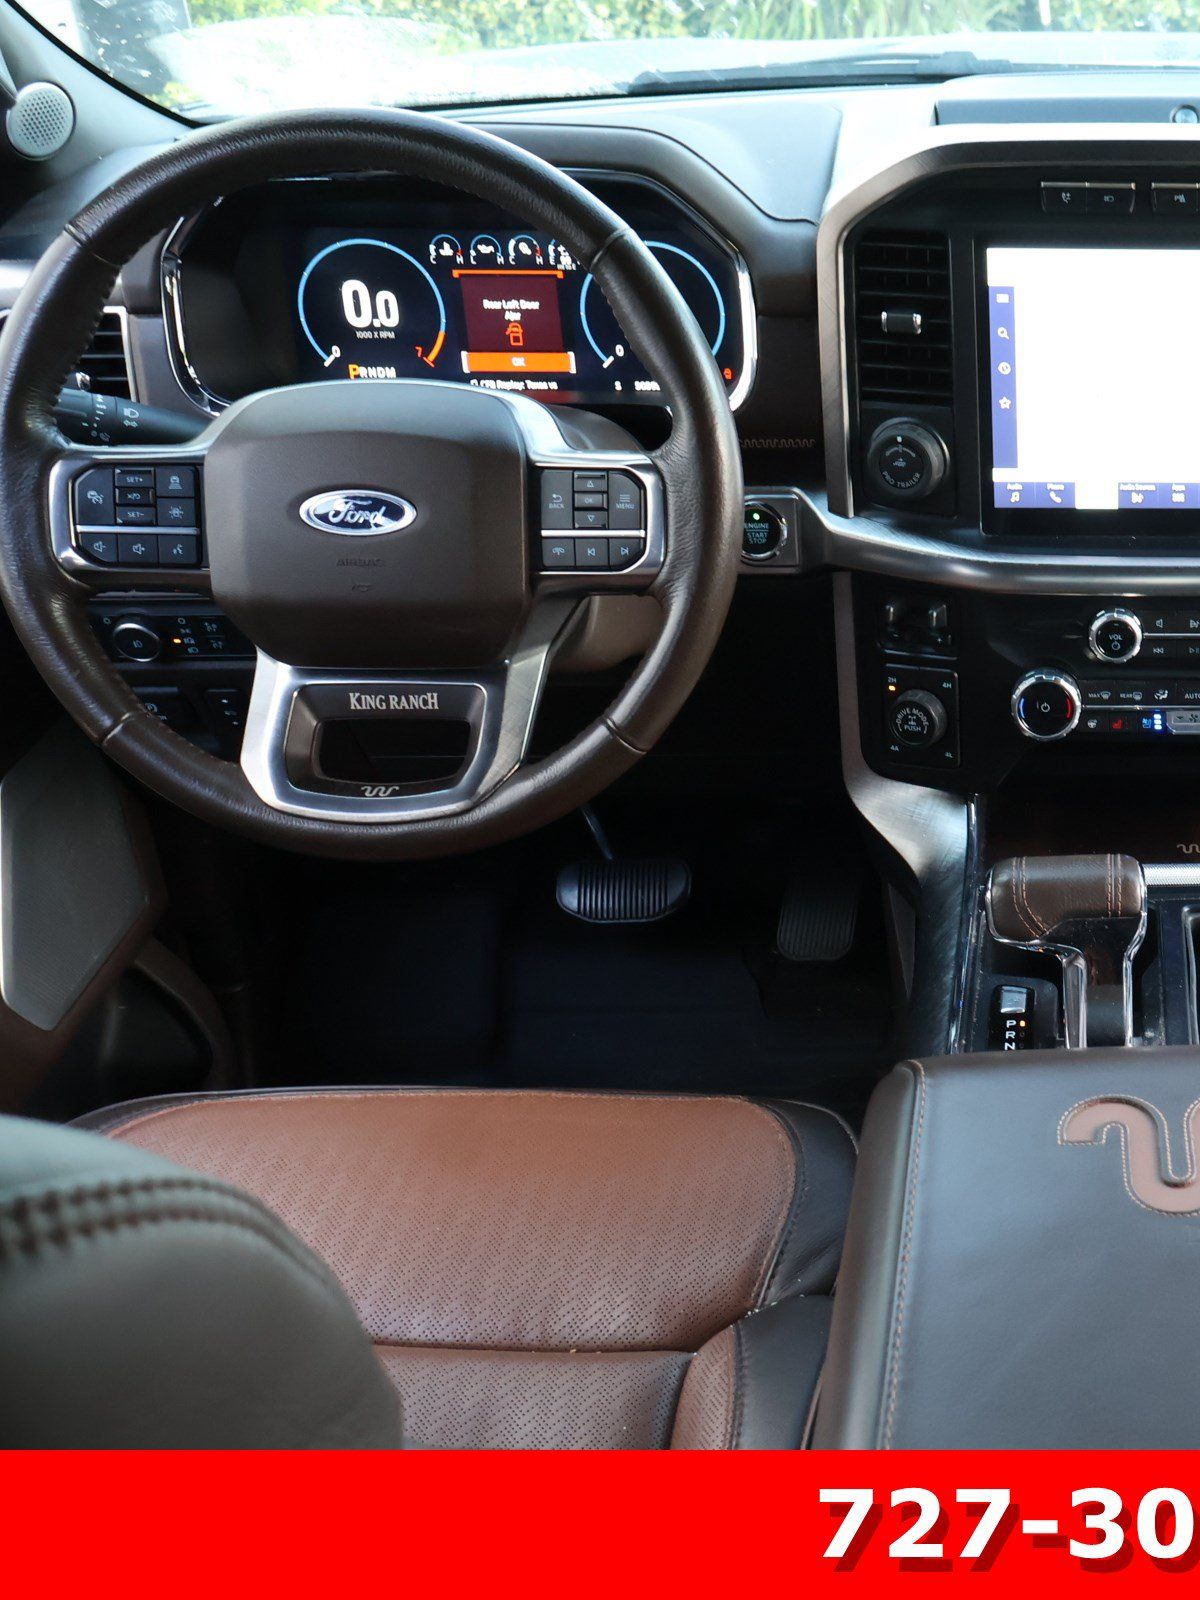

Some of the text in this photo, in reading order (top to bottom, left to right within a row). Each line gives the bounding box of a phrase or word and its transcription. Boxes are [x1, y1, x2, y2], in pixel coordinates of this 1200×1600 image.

[341, 279, 400, 328] 0.0
[380, 331, 396, 339] RPM
[615, 344, 625, 357] 0
[897, 472, 920, 488] TRAILER
[328, 498, 388, 528] Ford
[349, 692, 439, 710] KING RANCH
[896, 707, 929, 727] DRIVE MODE
[904, 724, 922, 732] PUSH
[1006, 1020, 1017, 1028] P
[1005, 1031, 1016, 1039] R
[1004, 1042, 1016, 1051] N
